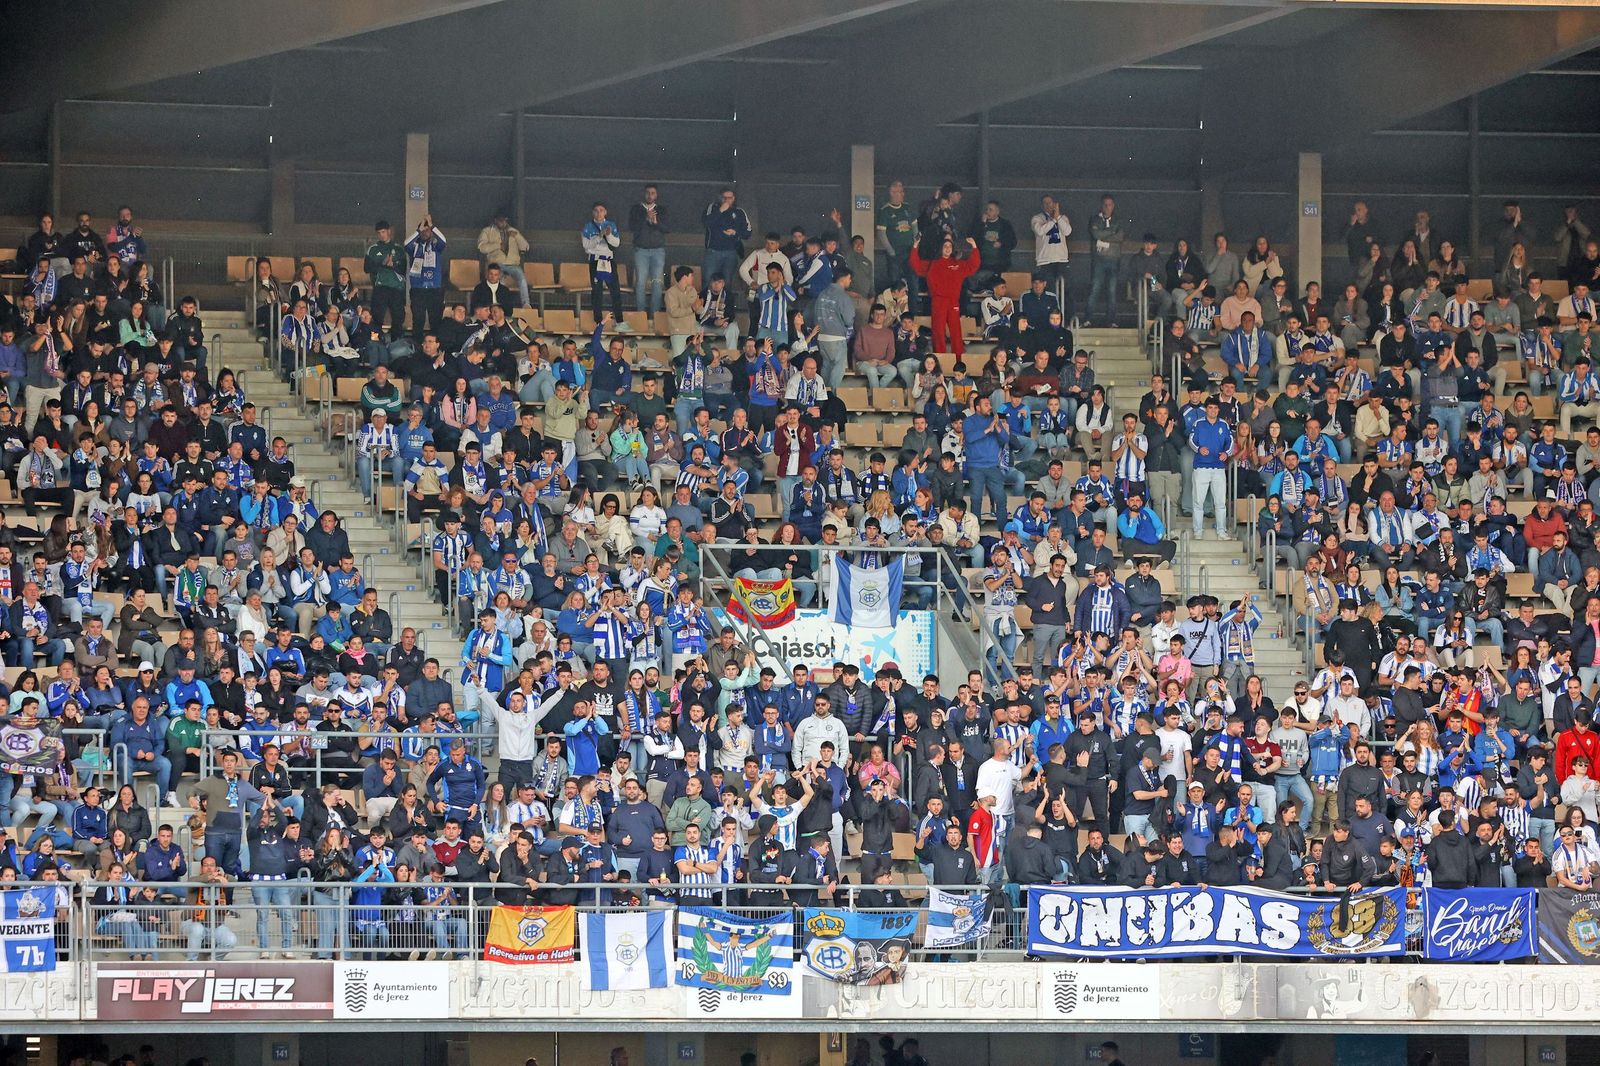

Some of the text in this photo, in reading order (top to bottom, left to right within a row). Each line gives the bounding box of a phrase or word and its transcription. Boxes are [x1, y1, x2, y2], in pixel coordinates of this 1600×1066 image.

[410, 190, 425, 198] 342
[856, 201, 871, 209] 342
[1304, 207, 1318, 215] 341
[312, 738, 327, 747] 242
[1280, 739, 1298, 750] HH
[880, 914, 914, 930] 1889
[489, 946, 535, 961] Recreativo
[537, 952, 549, 960] de
[682, 962, 695, 980] 18
[768, 971, 788, 989] 89
[112, 978, 198, 1001] PLAY
[373, 982, 437, 992] Ayuntamiento
[1083, 984, 1148, 994] Ayuntamiento
[373, 992, 408, 1003] de Jerez
[727, 993, 763, 1003] de Jerez
[1083, 994, 1120, 1004] de Jerez
[276, 1050, 288, 1058] 141
[681, 1050, 694, 1058] 141
[1542, 1052, 1555, 1061] 140
